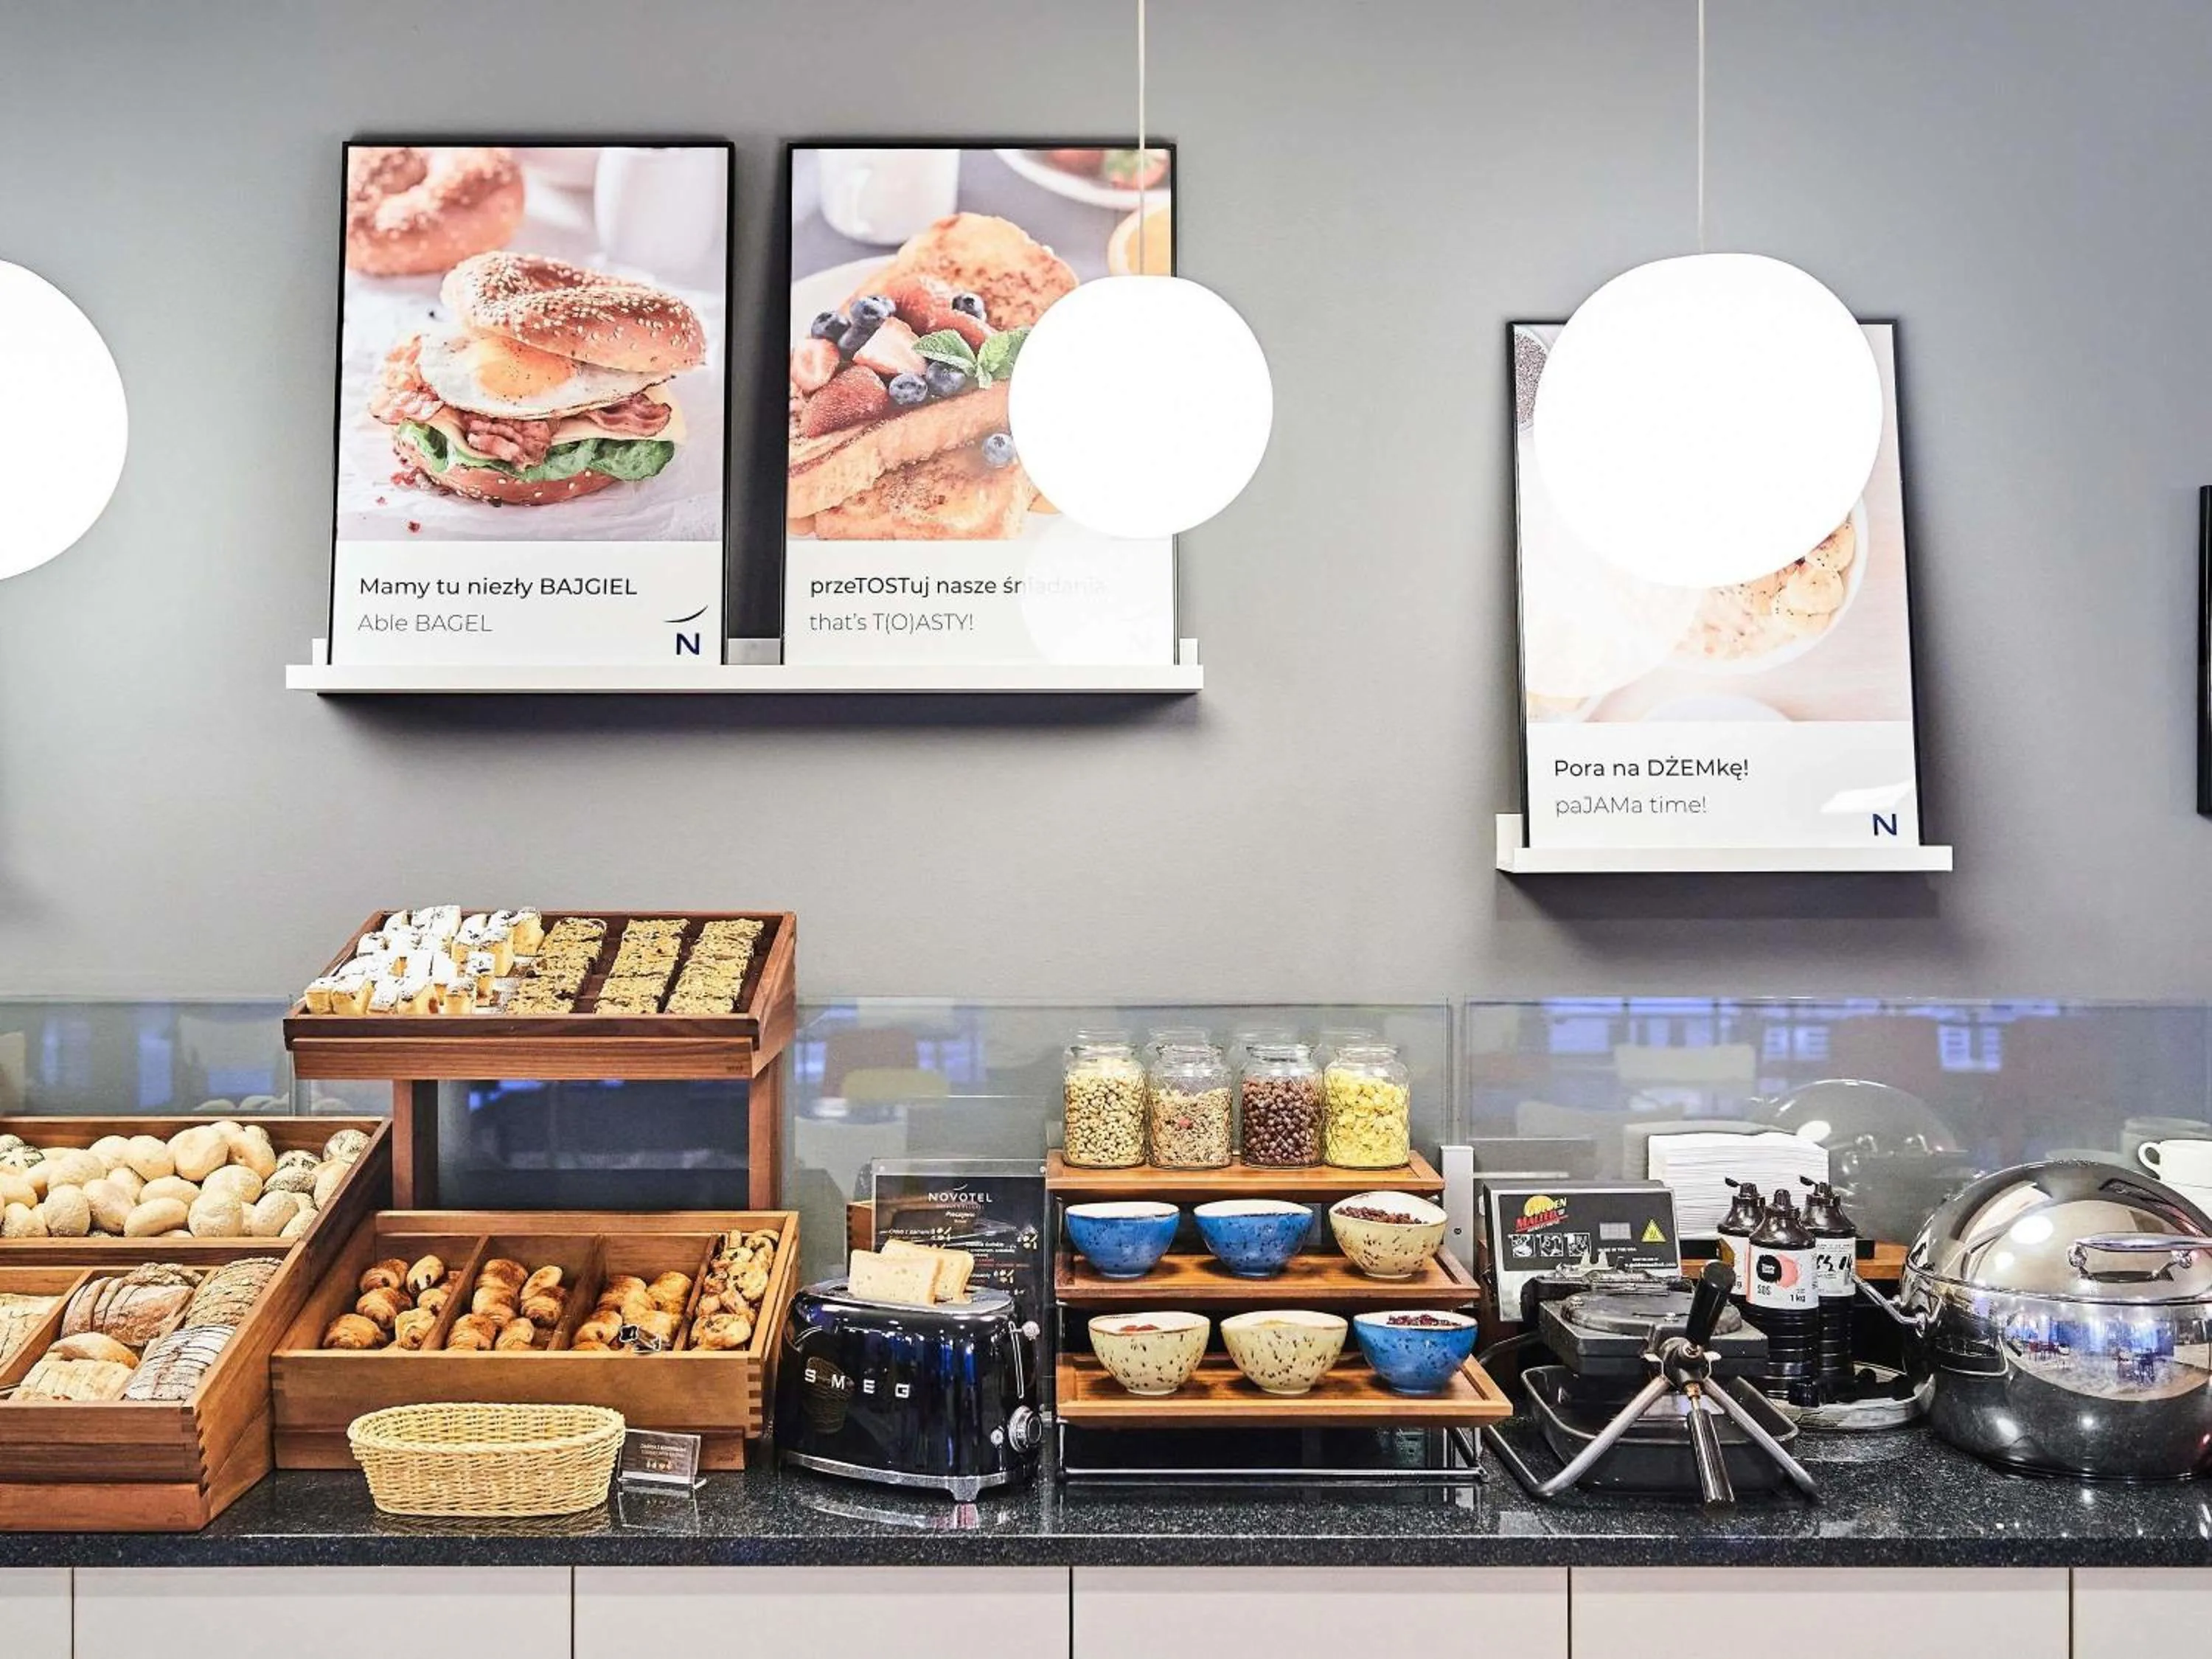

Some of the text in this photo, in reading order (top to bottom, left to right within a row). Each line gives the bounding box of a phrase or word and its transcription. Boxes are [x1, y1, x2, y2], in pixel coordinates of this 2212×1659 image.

[361, 577, 638, 599] Mamy tu niezły BAJGIEL
[810, 577, 929, 598] przeTOSTuj
[936, 580, 997, 594] nasze
[357, 613, 493, 632] Able BAGEL
[872, 613, 973, 635] T(O)ASTY!
[676, 632, 700, 655] N
[1554, 755, 1748, 781] Pora na DŻEMkę!
[1556, 796, 1707, 818] paJAMa time!
[1872, 813, 1897, 836] N
[928, 1192, 993, 1203] NOVOTEL
[1796, 1294, 1806, 1303] kg
[804, 1368, 911, 1399] SMEG
